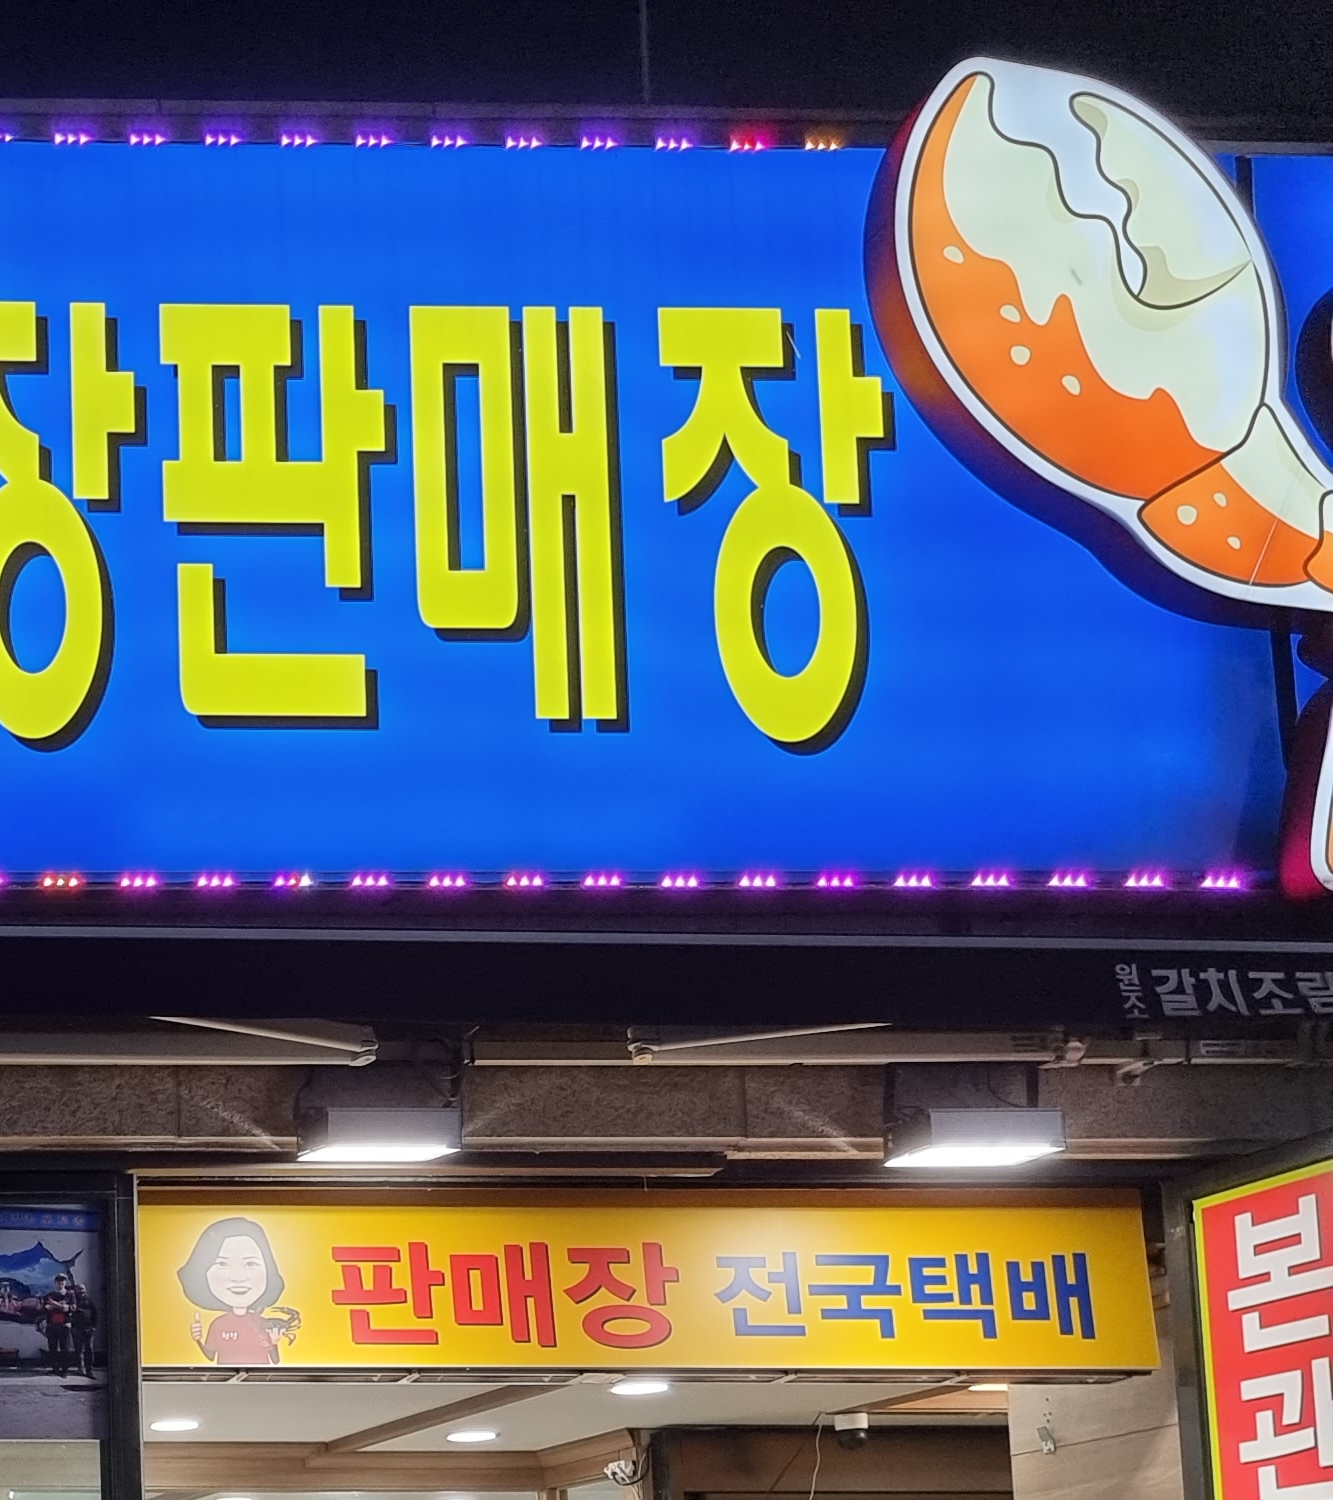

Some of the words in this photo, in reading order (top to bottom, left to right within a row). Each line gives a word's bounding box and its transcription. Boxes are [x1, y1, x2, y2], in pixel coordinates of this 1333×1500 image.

[1114, 963, 1150, 1019] 원조
[331, 1241, 681, 1350] 판매장
[713, 1251, 1097, 1341] 전국택배
